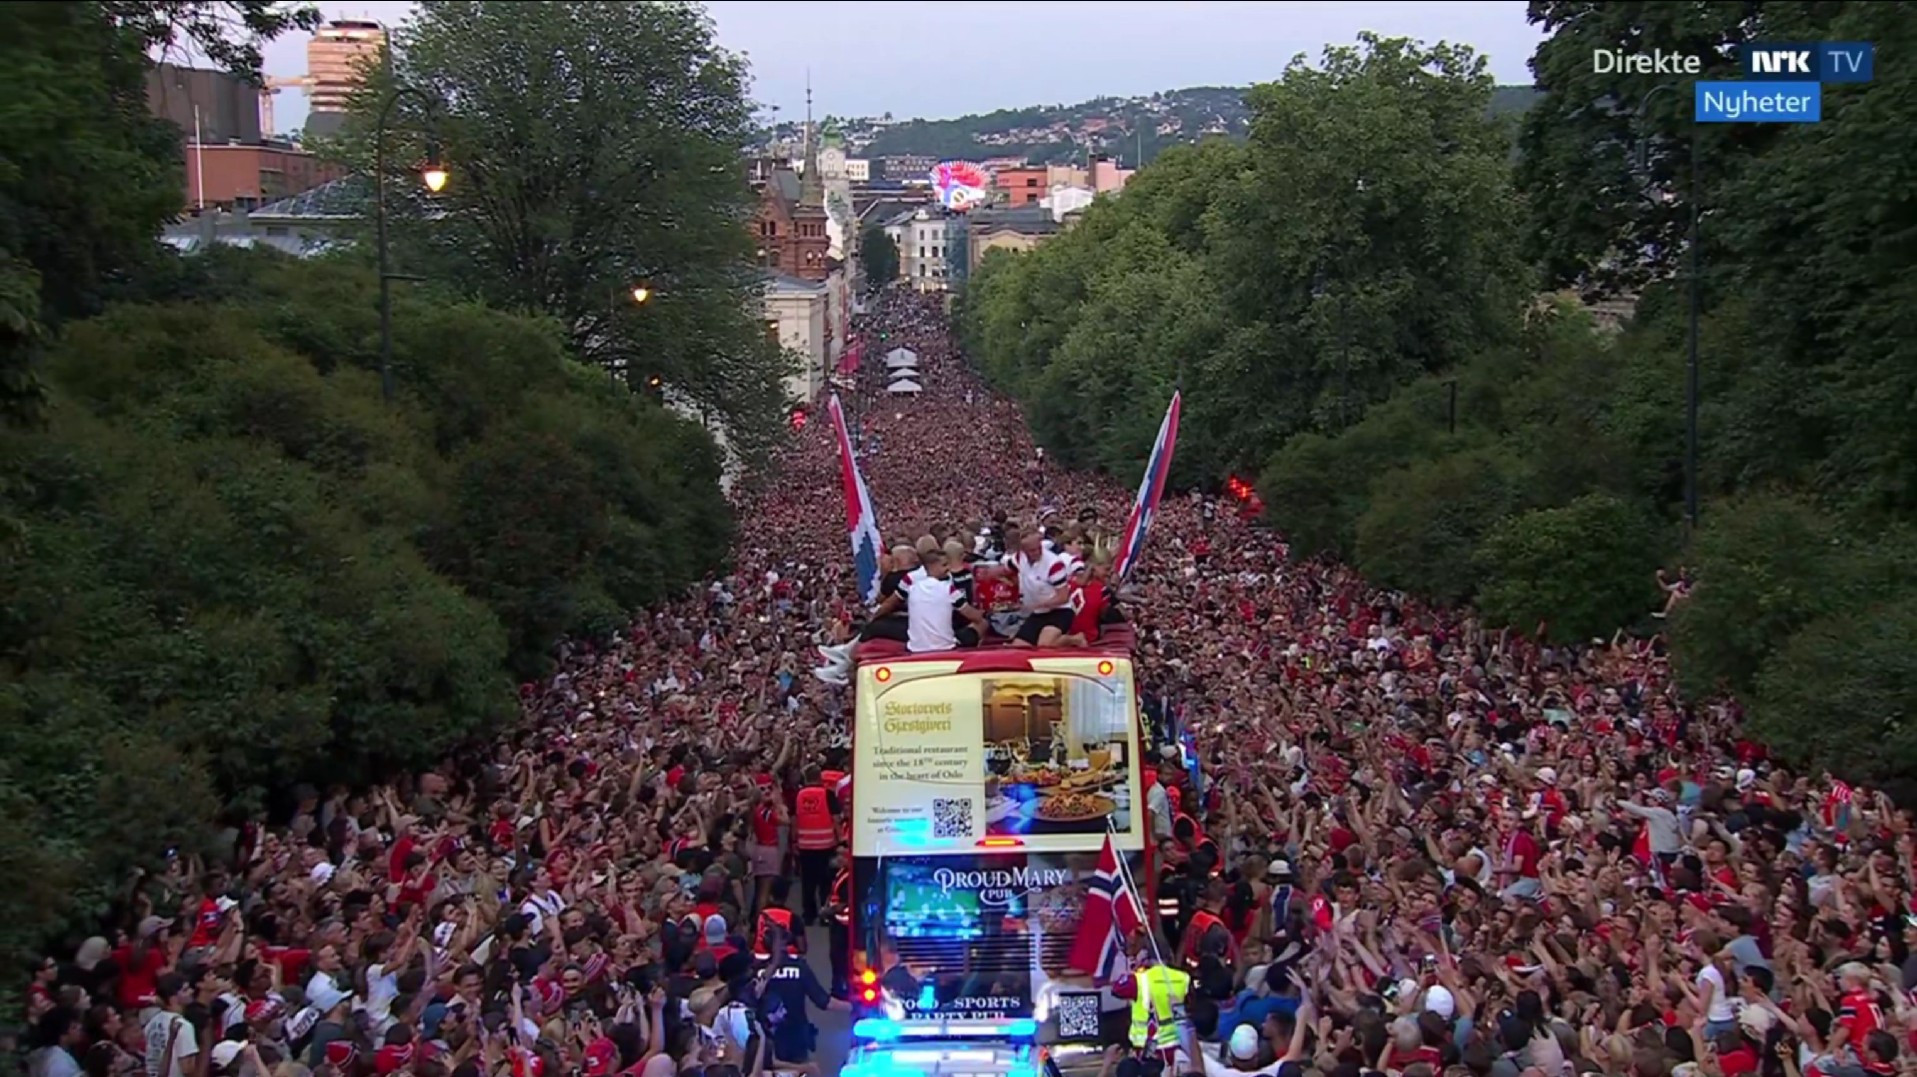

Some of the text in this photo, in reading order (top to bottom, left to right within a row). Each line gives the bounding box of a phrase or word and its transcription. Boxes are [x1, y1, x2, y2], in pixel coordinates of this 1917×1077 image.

[873, 745, 968, 755] Traditional restaurant
[873, 758, 894, 767] since
[896, 758, 911, 767] the
[934, 758, 968, 770] century
[879, 769, 963, 781] in the heart of Oslo
[954, 996, 1021, 1010] SPORTS
